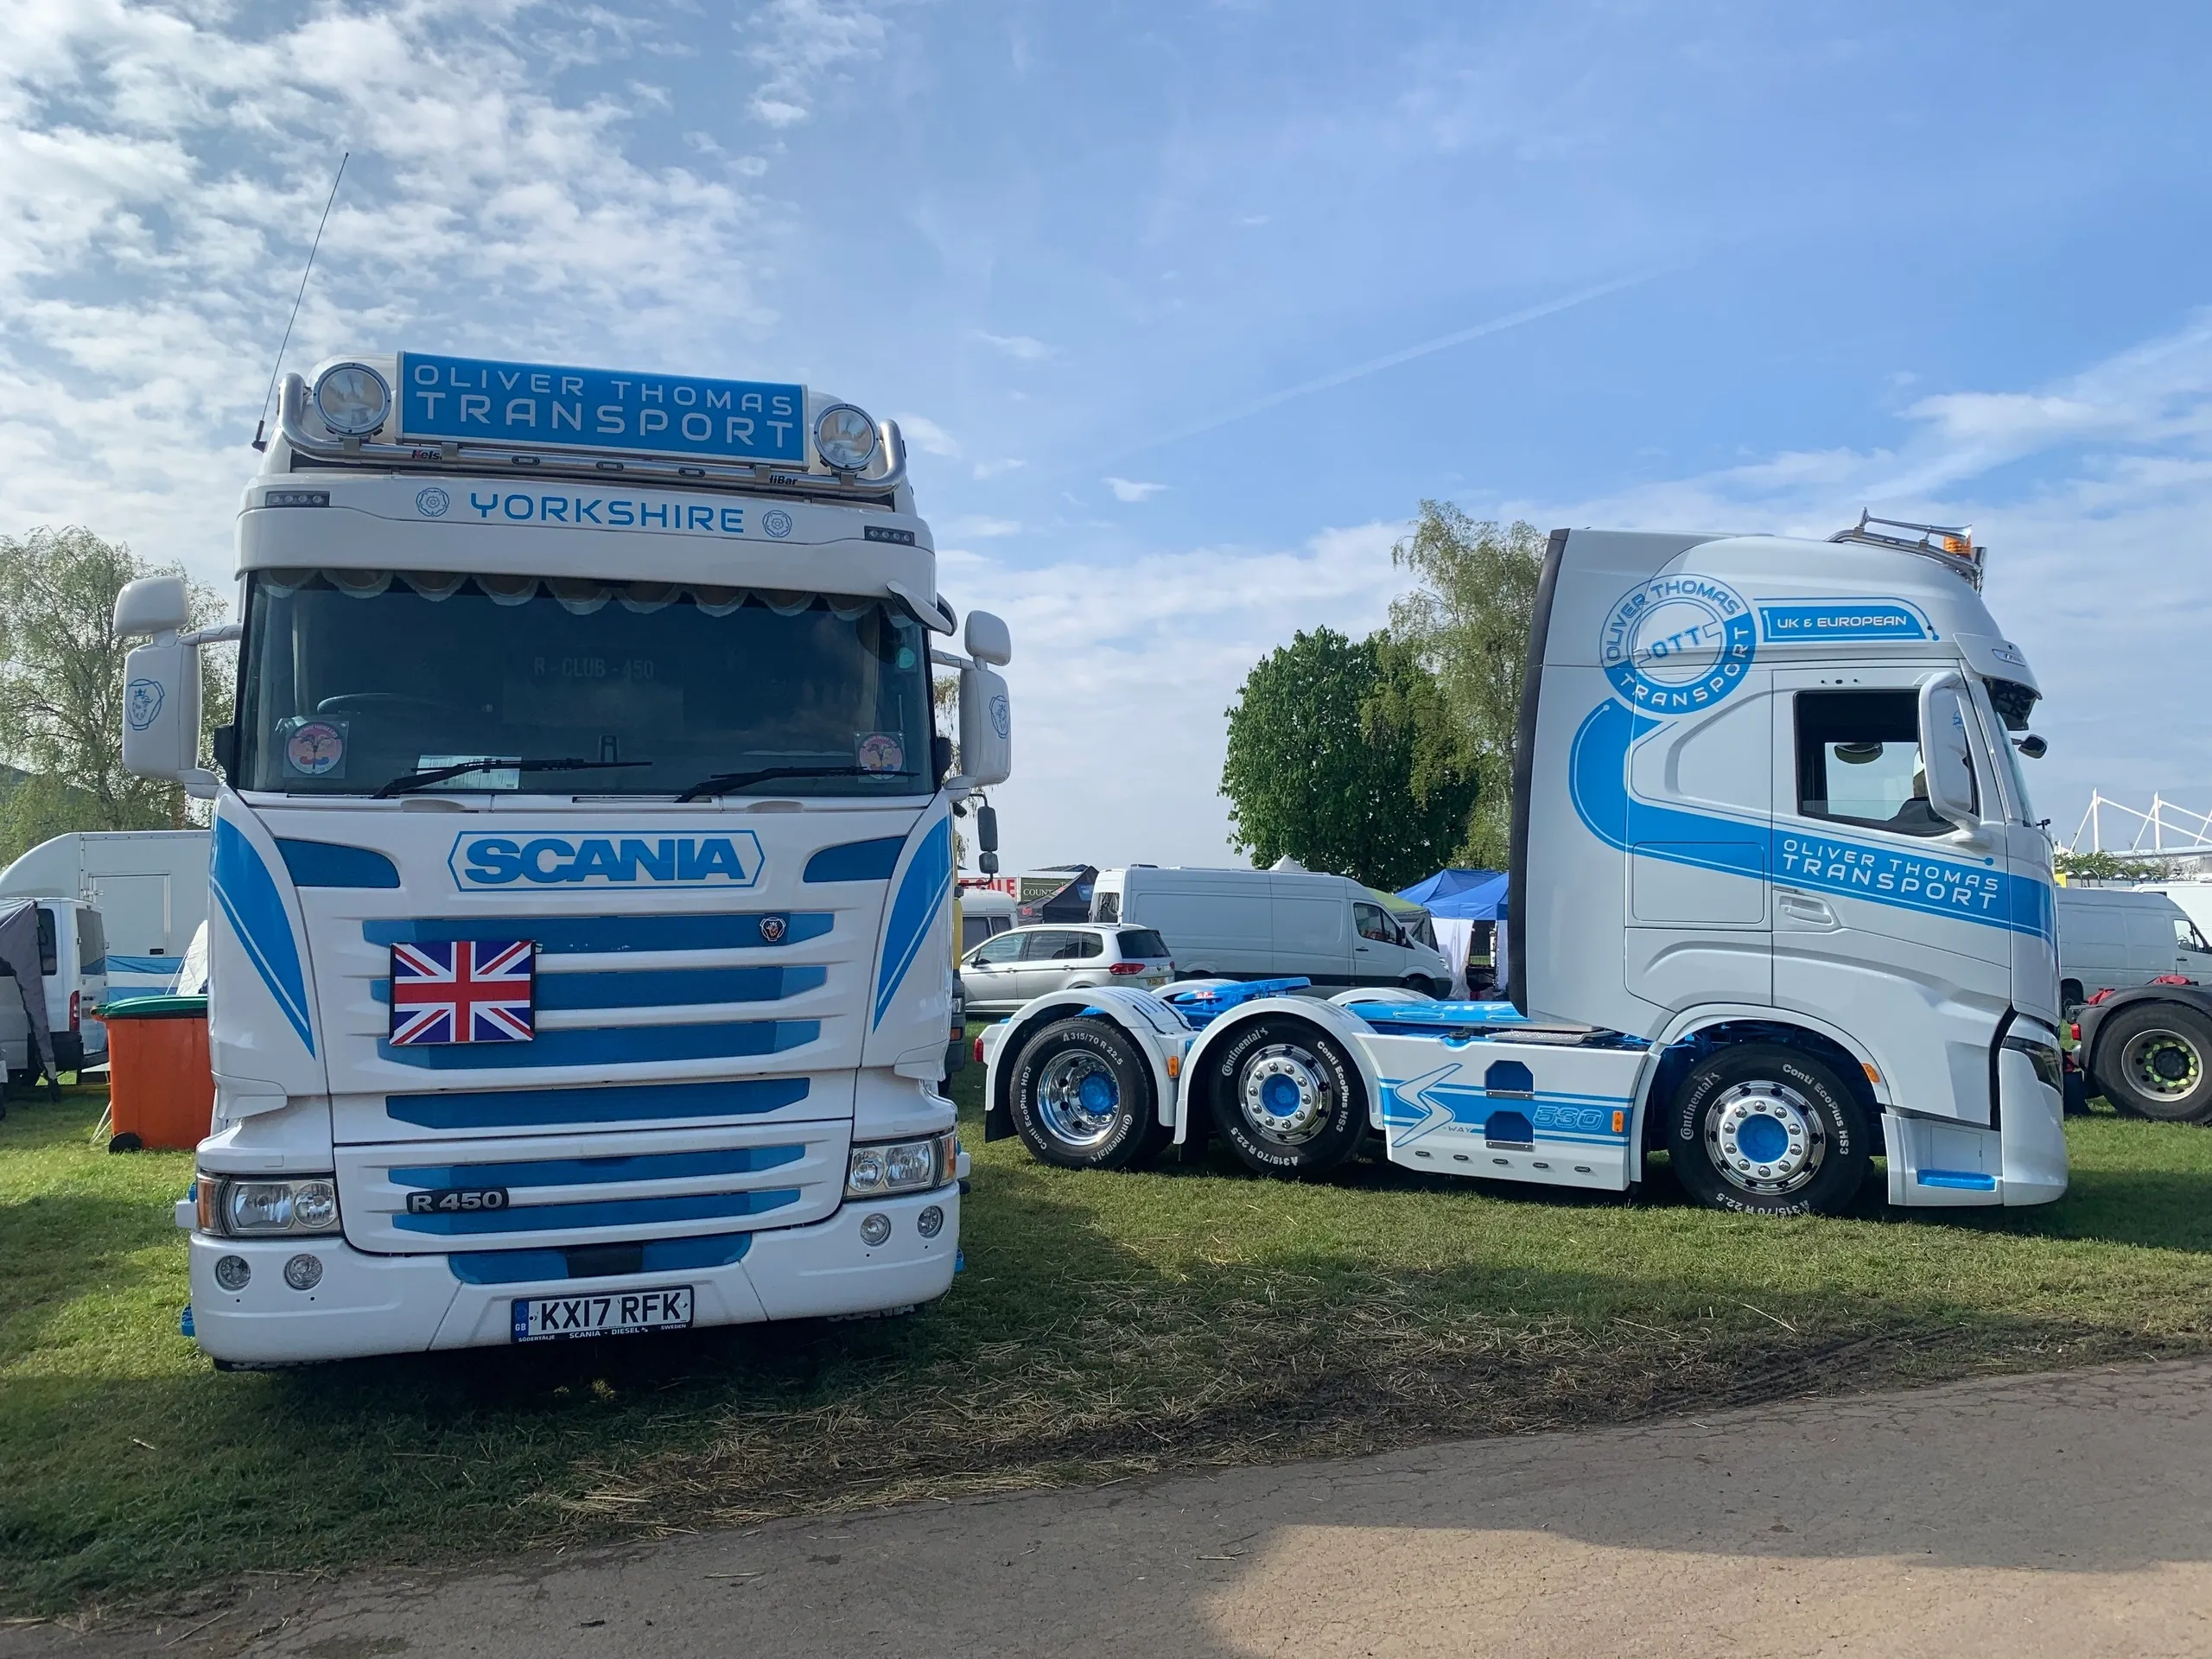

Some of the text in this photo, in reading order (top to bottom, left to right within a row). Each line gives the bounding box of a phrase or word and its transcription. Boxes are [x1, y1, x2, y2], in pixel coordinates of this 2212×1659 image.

[414, 364, 793, 416] OLIVER THOMAS
[416, 391, 793, 448] TRANSPORT
[411, 449, 442, 461] Kels
[470, 493, 745, 533] YORKSHIRE
[1606, 580, 1740, 661] OLIVER THOMAS
[1777, 616, 1906, 628] UK & EUROPEAN
[1651, 625, 1700, 658] OTT
[1620, 626, 1749, 707] TRANSPORT
[464, 837, 746, 884] SCANIA
[1783, 839, 1999, 892] OLIVER THOMAS
[1783, 853, 1997, 909] TRANSPORT
[1071, 1032, 1123, 1065] 315/70 R 22.5
[1317, 1040, 1350, 1132] Conti EcoPlus HS3
[1020, 1065, 1047, 1150] Conti EcoPlus HD3
[1533, 1105, 1604, 1130] 530
[1782, 1063, 1849, 1155] Conti EcoPlus HS3
[1230, 1127, 1249, 1147] 22.5
[412, 1191, 503, 1212] R 450
[514, 1323, 526, 1332] GB
[541, 1292, 681, 1331] KX17 RFK
[569, 1330, 601, 1339] SCANIA
